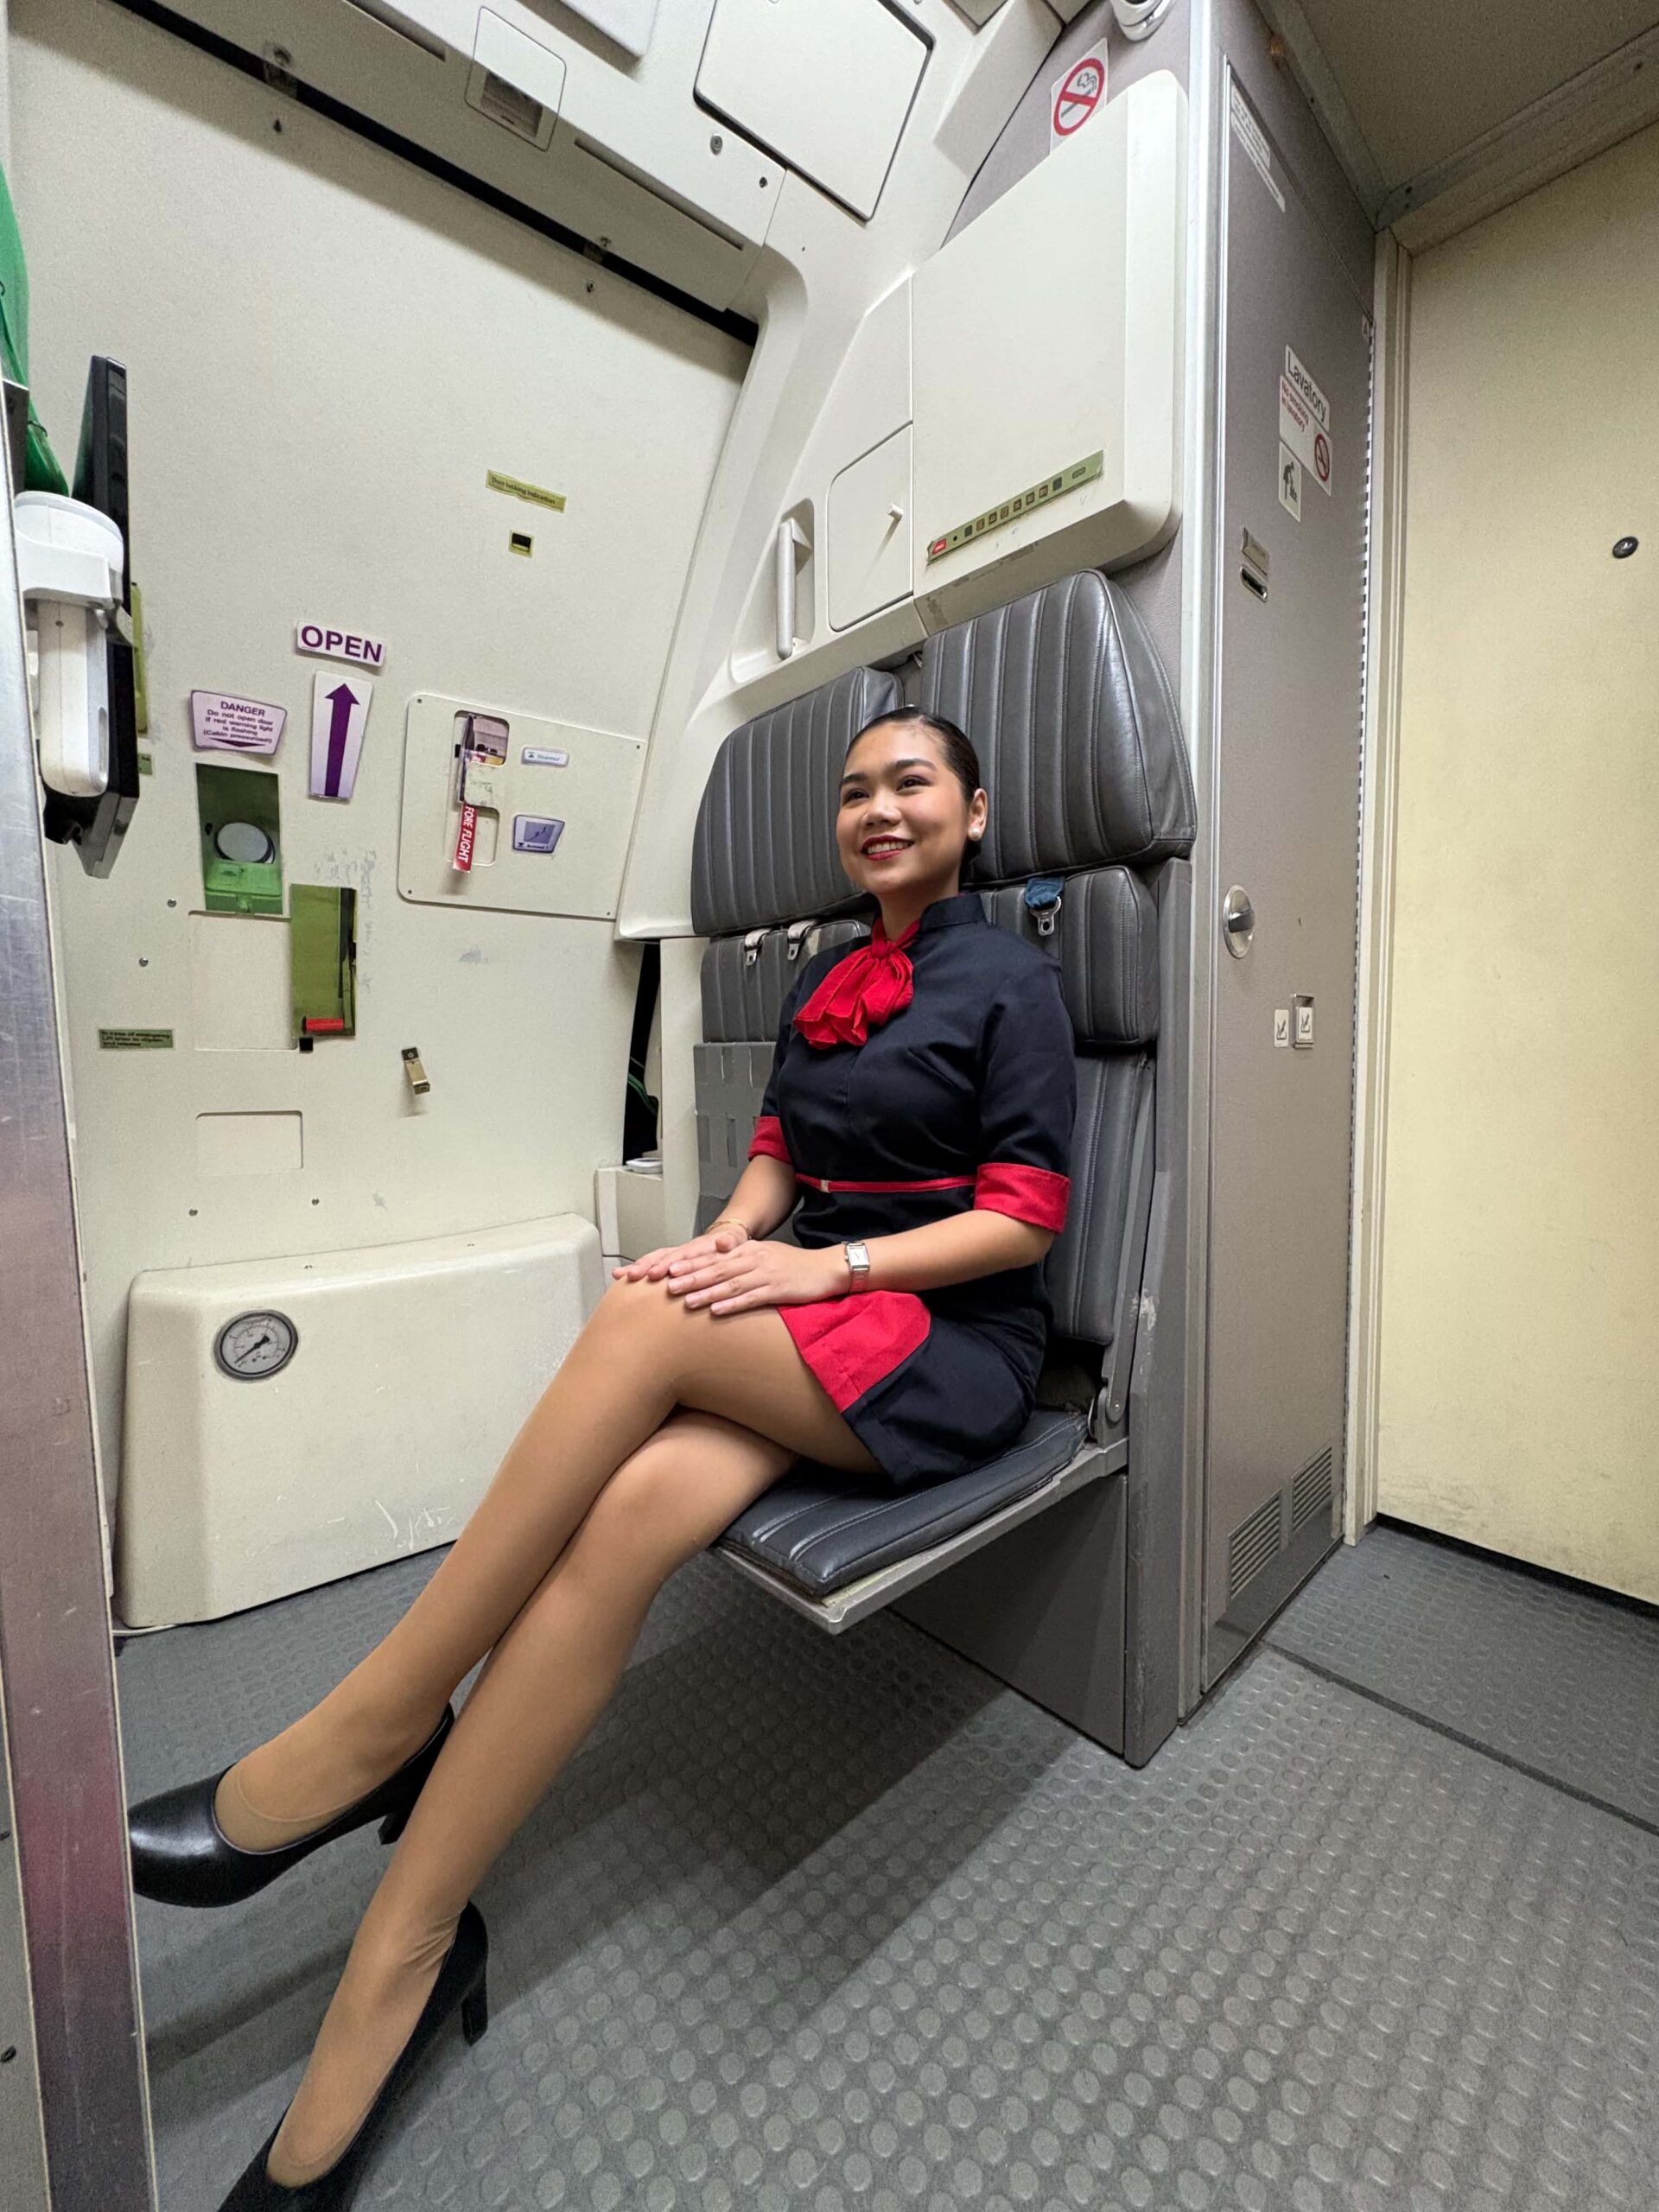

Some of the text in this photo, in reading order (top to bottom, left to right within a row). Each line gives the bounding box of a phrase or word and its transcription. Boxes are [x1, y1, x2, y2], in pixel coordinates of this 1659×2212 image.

[1287, 350, 1326, 423] Lavatory
[301, 626, 382, 663] OPEN
[207, 709, 219, 717] Do
[237, 715, 256, 723] open
[220, 702, 265, 716] DANGER
[228, 720, 257, 730] warning
[457, 829, 473, 863] FLIGHT
